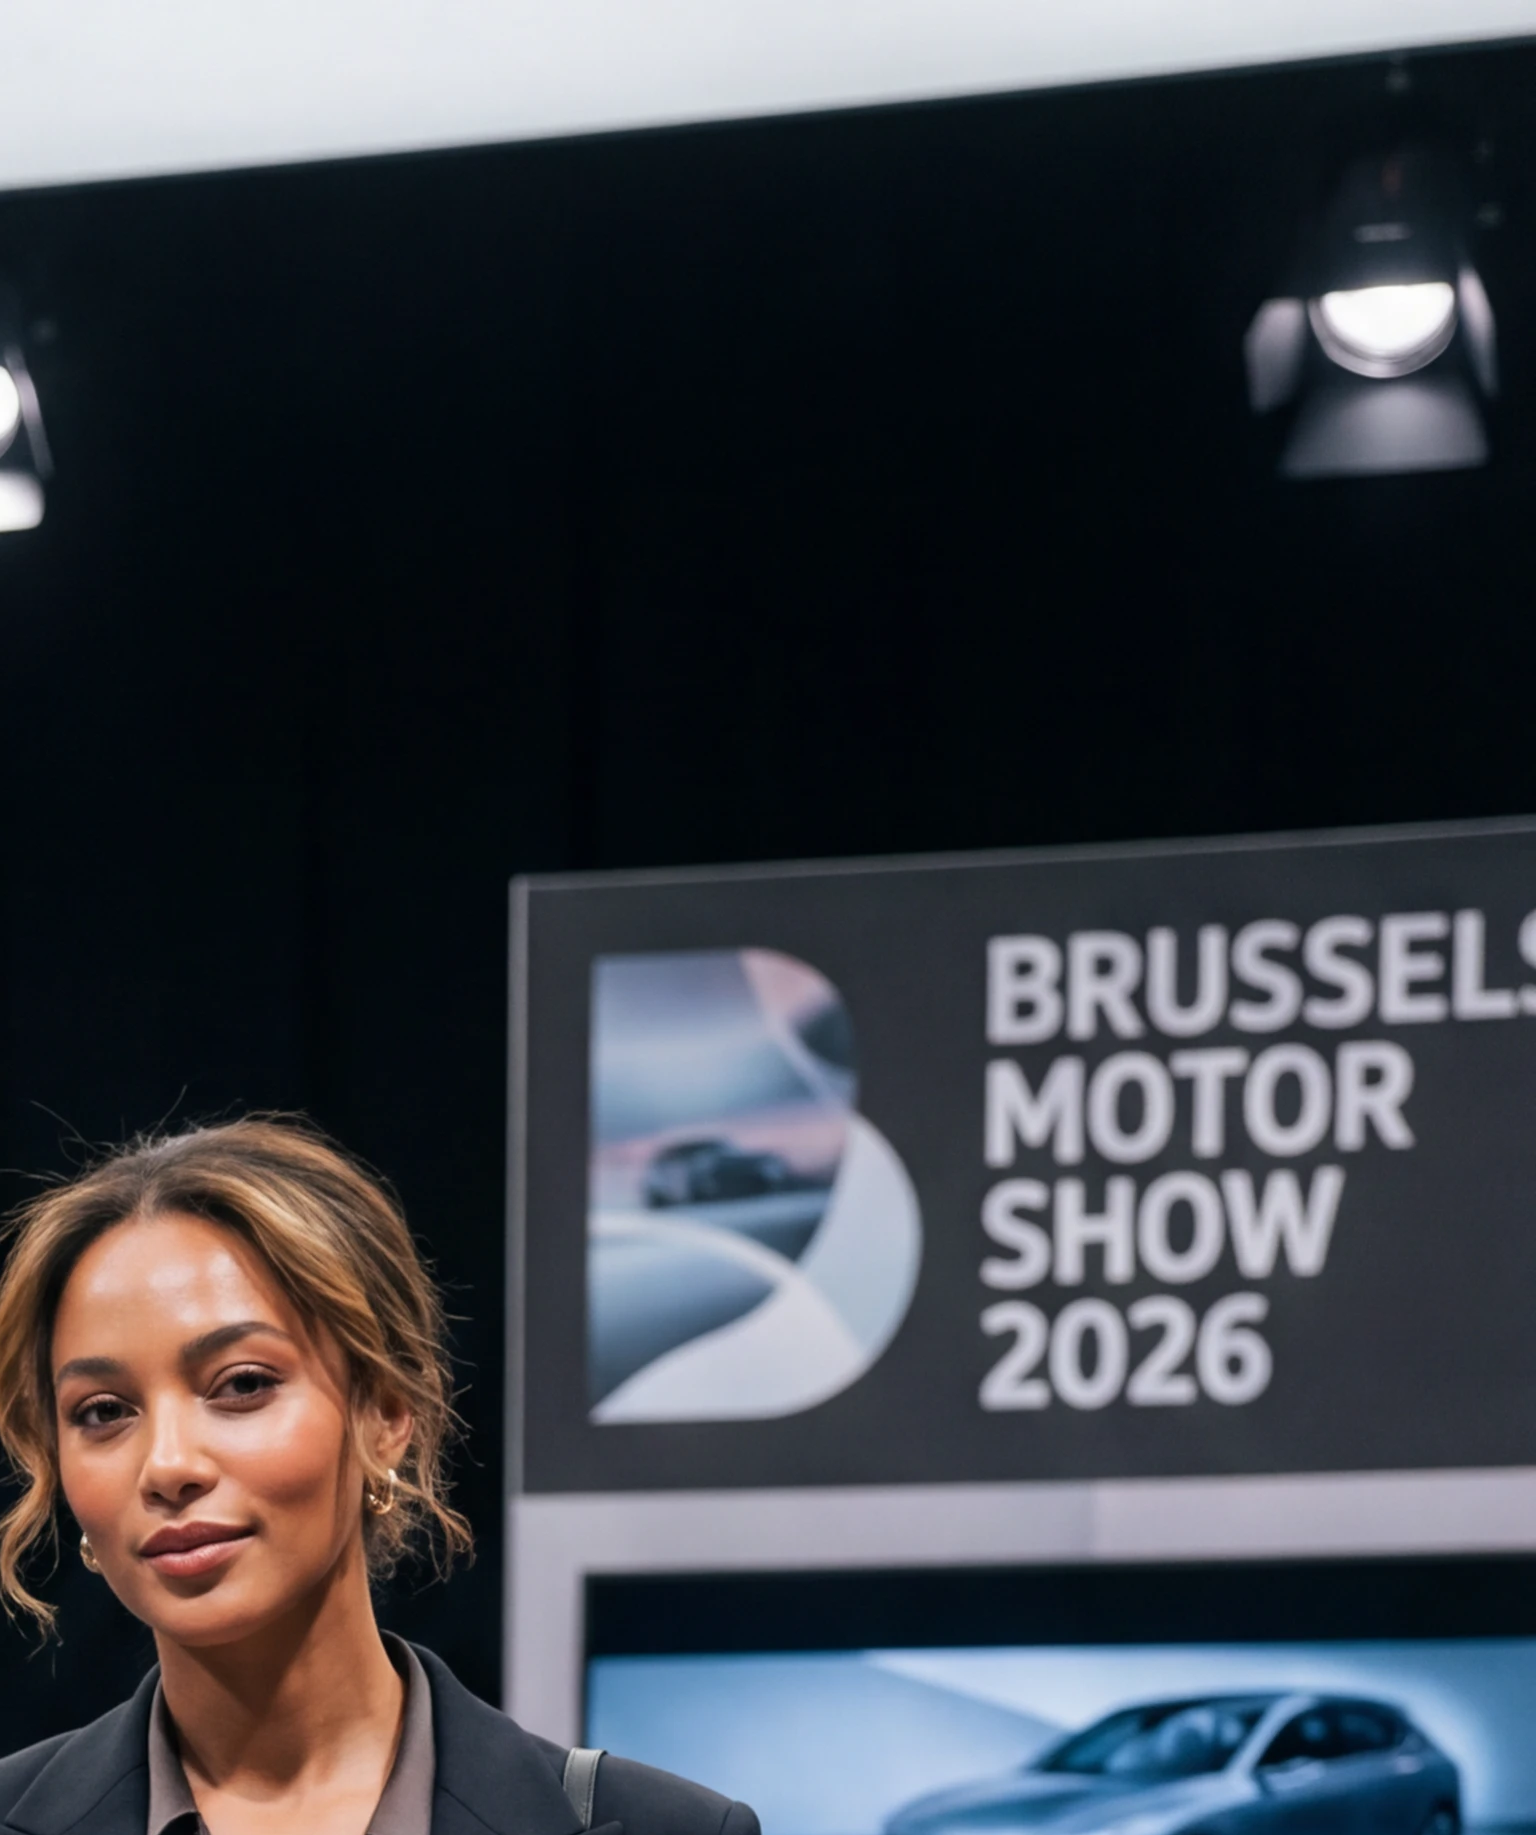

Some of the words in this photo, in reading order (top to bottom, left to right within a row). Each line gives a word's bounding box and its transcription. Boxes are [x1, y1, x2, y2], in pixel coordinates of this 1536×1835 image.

[984, 1041, 1412, 1167] MOTOR
[980, 1166, 1344, 1290] SHOW
[979, 1293, 1272, 1411] 2026
